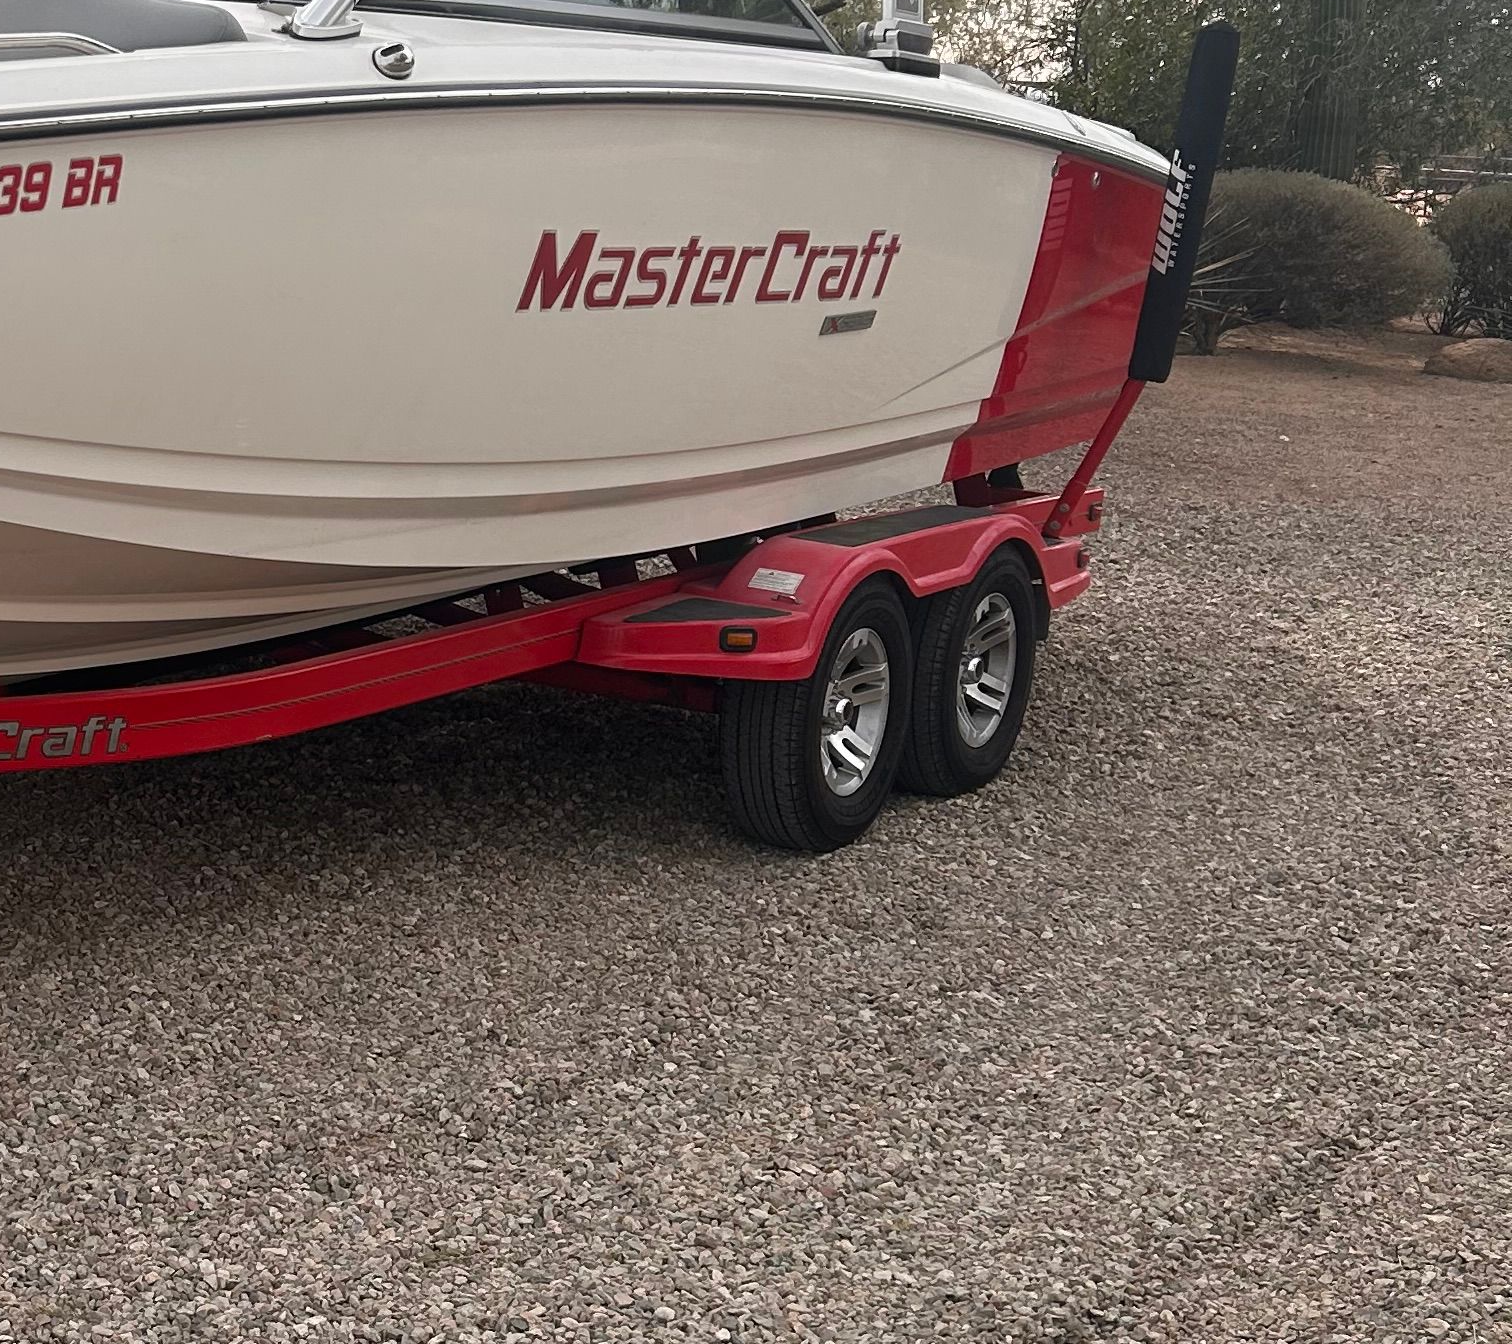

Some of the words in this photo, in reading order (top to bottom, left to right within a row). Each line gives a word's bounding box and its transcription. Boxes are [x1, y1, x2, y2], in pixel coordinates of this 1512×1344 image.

[61, 154, 124, 208] BR
[1151, 148, 1187, 275] WOLF
[1168, 163, 1196, 268] WATERSPORTS
[515, 229, 902, 313] MasterCraft
